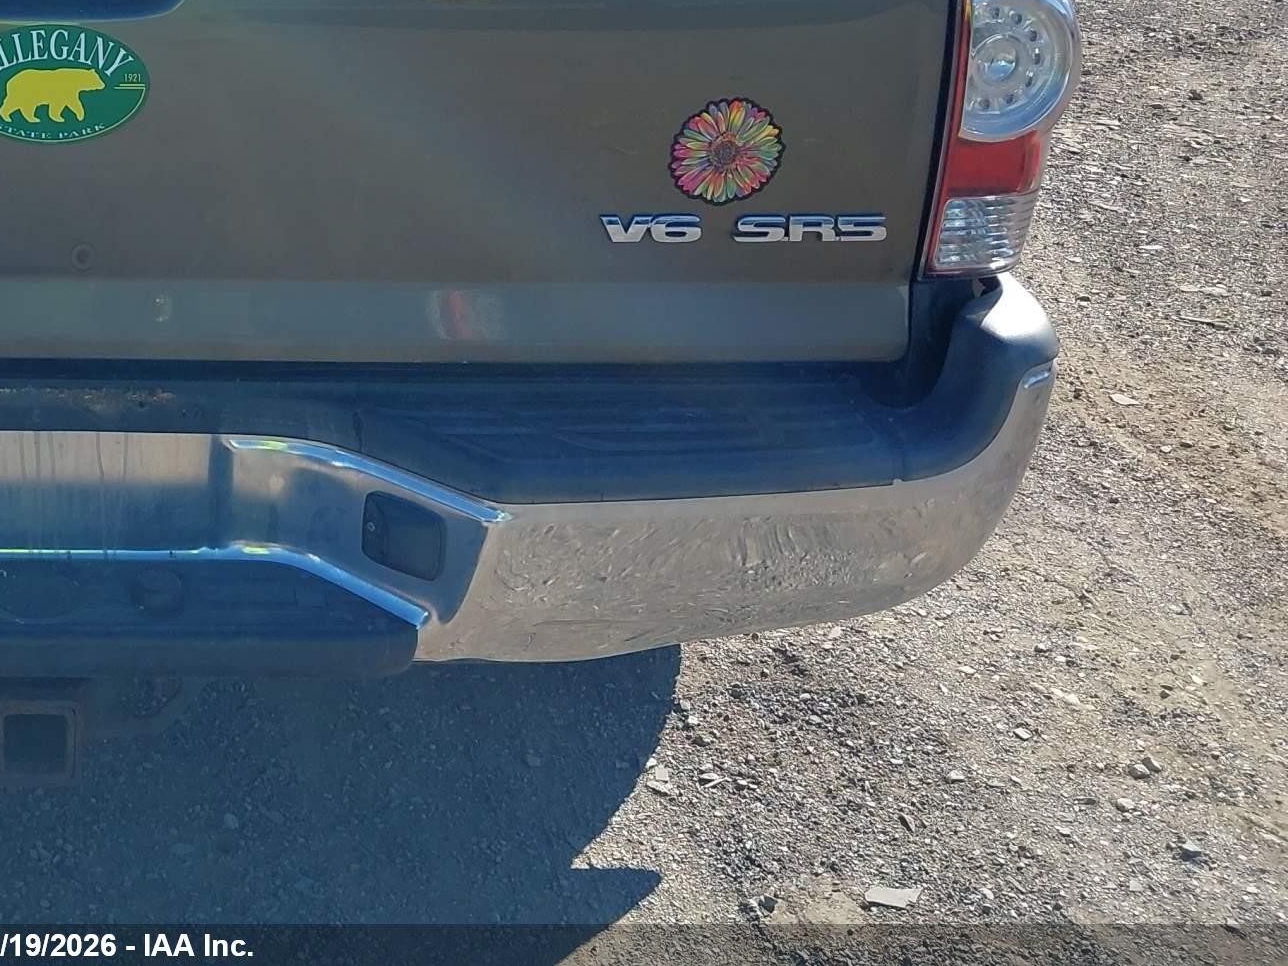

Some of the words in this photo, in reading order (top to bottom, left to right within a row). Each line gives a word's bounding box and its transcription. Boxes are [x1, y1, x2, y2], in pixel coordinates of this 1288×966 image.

[124, 74, 141, 82] 1921
[59, 122, 106, 139] PARK
[600, 214, 702, 243] V6
[733, 214, 887, 243] SR5
